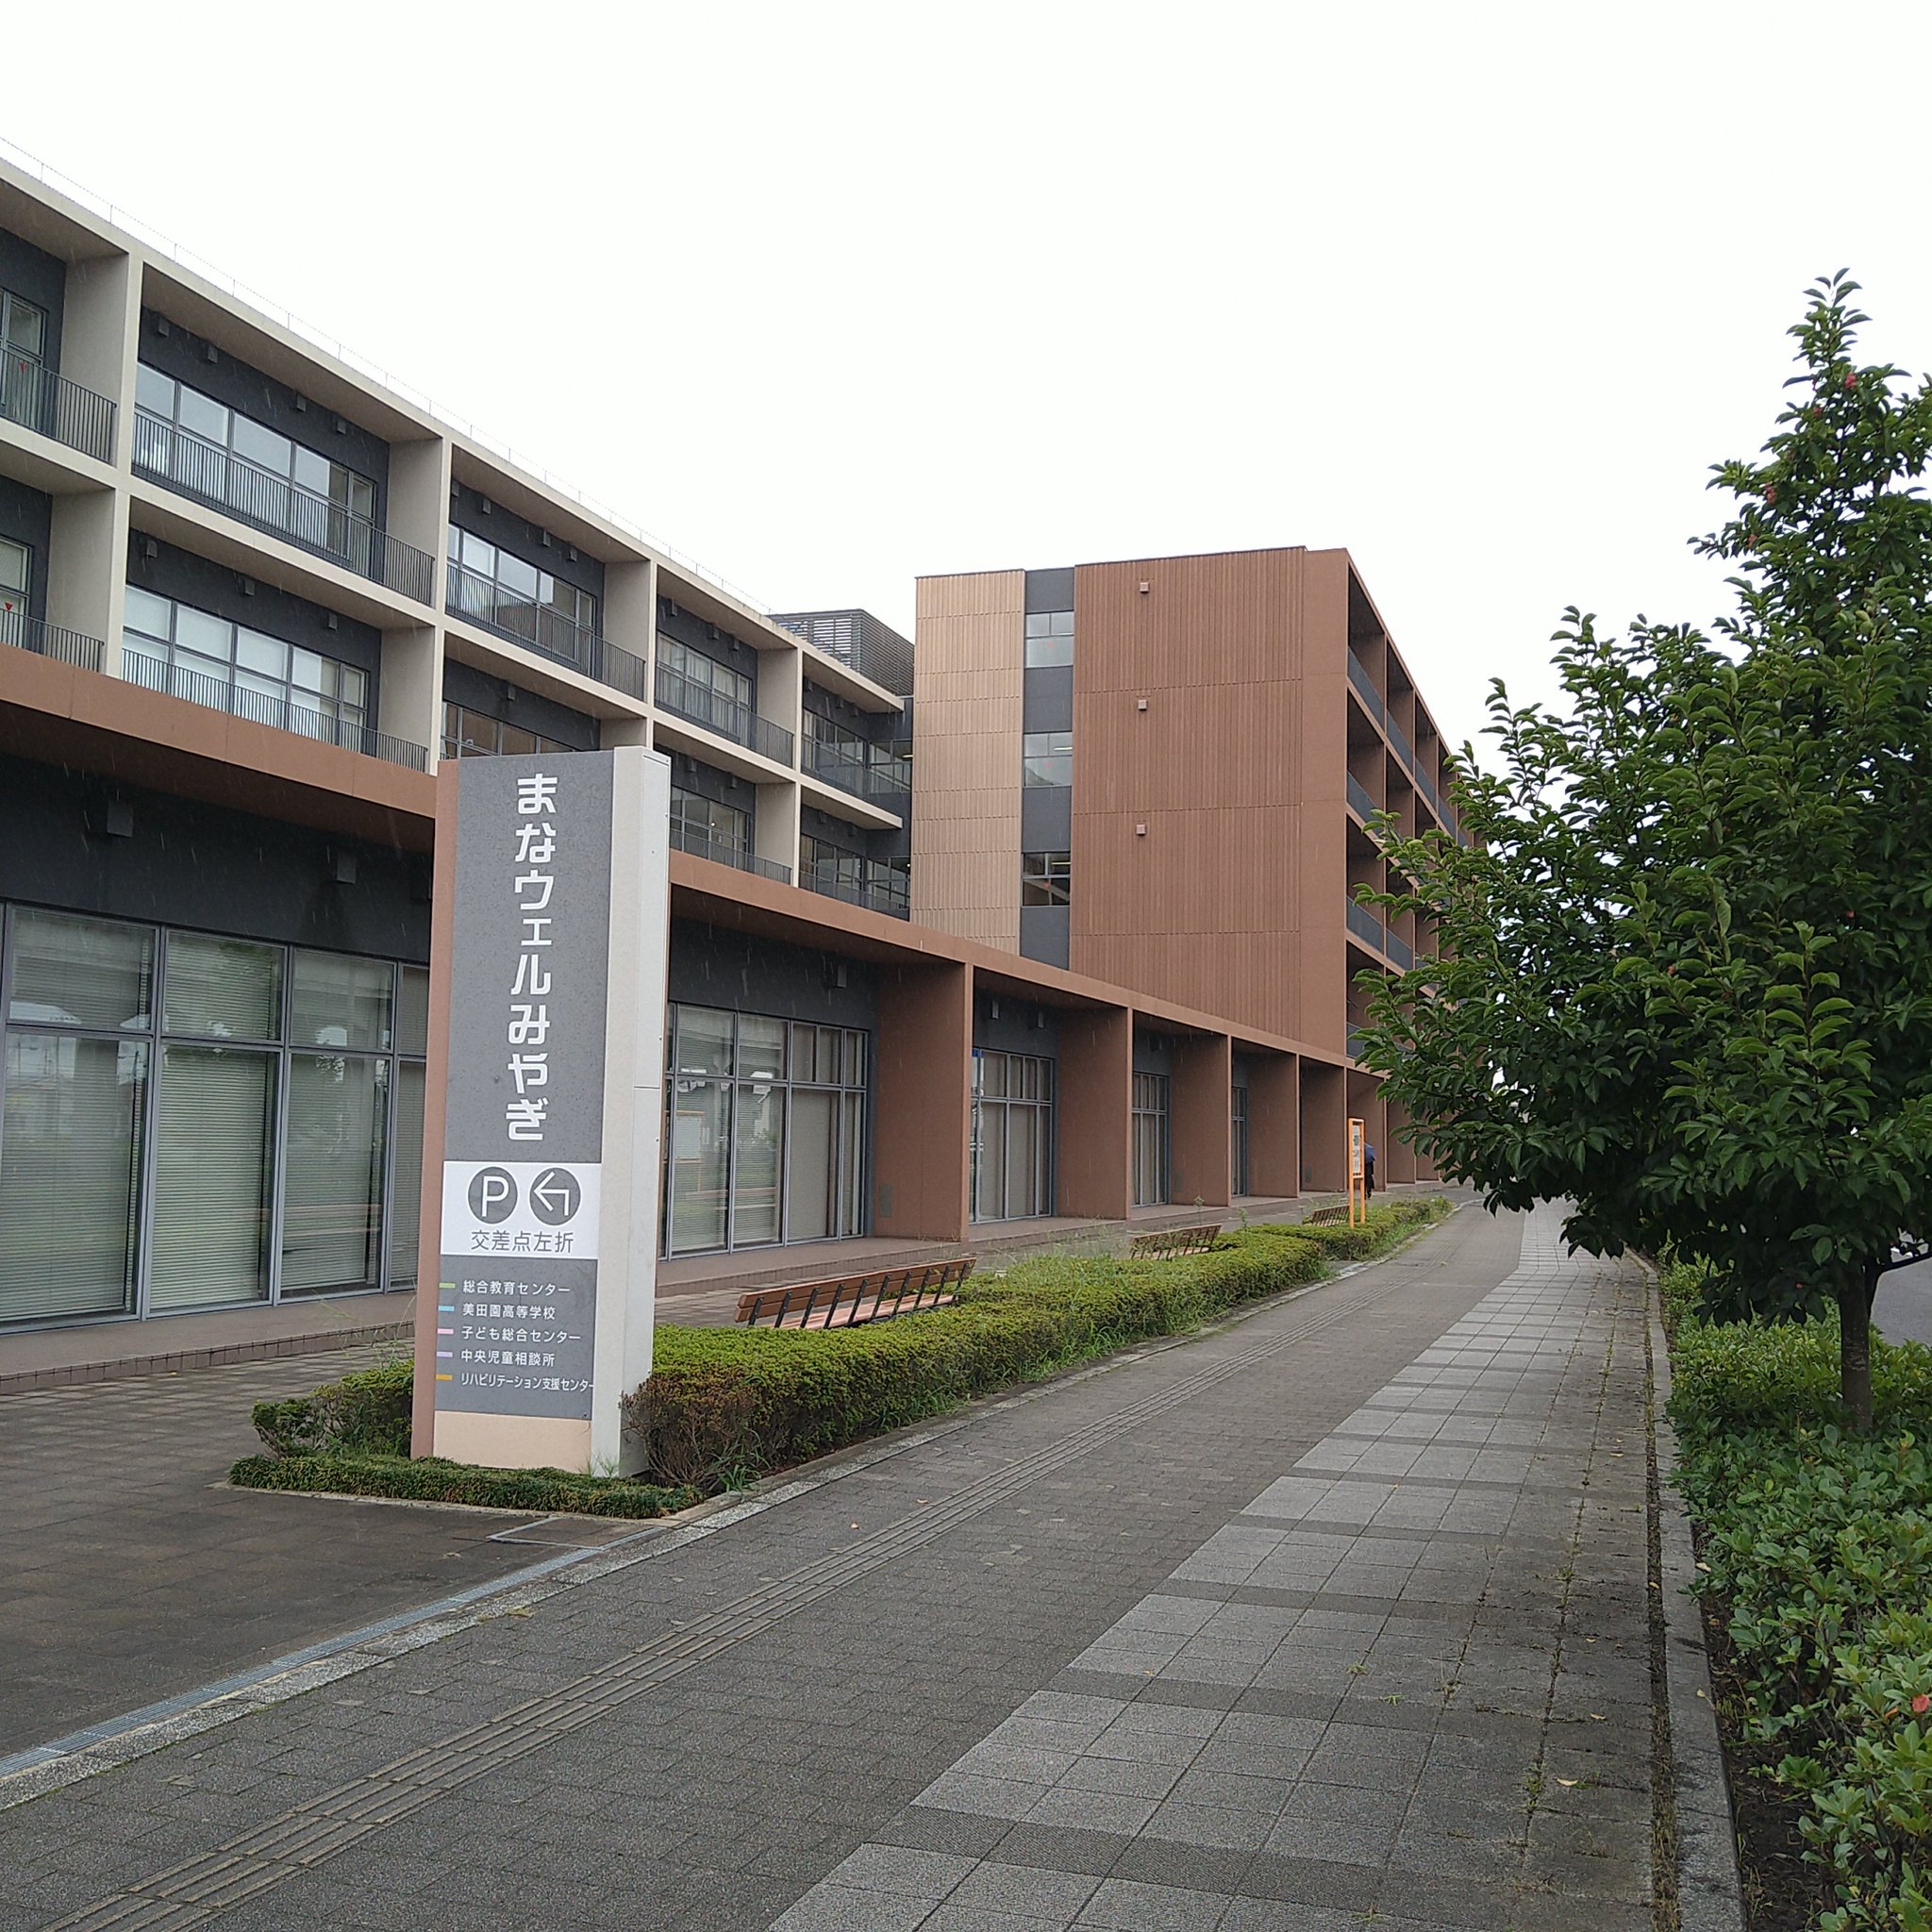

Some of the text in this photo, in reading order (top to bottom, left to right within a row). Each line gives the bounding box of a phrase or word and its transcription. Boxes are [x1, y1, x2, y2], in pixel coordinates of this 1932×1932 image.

[471, 1230, 575, 1254] 交差点左折
[462, 1279, 571, 1296] 総合教育センター
[462, 1303, 556, 1320] 美田園高等学校
[461, 1325, 581, 1343] 子ども総合センター
[460, 1349, 556, 1367] 中央児童相談所
